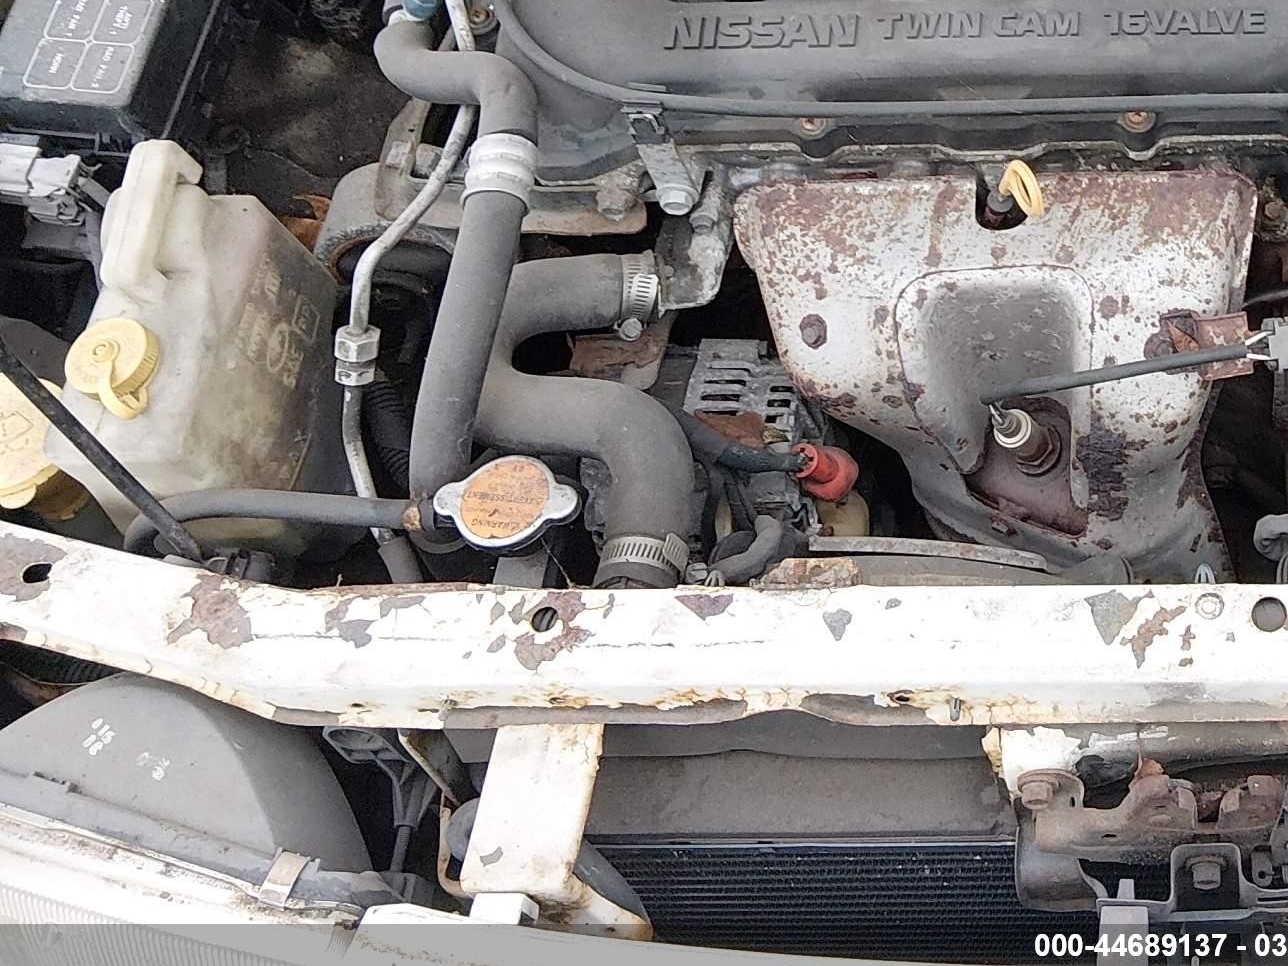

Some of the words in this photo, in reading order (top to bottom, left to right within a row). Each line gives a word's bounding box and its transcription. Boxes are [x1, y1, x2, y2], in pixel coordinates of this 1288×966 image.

[67, 14, 80, 30] FAN
[663, 15, 860, 49] NISSAN
[877, 12, 983, 40] TWIN
[994, 10, 1081, 37] CAM
[1103, 9, 1267, 36] 16VALVE
[49, 52, 64, 74] HORN
